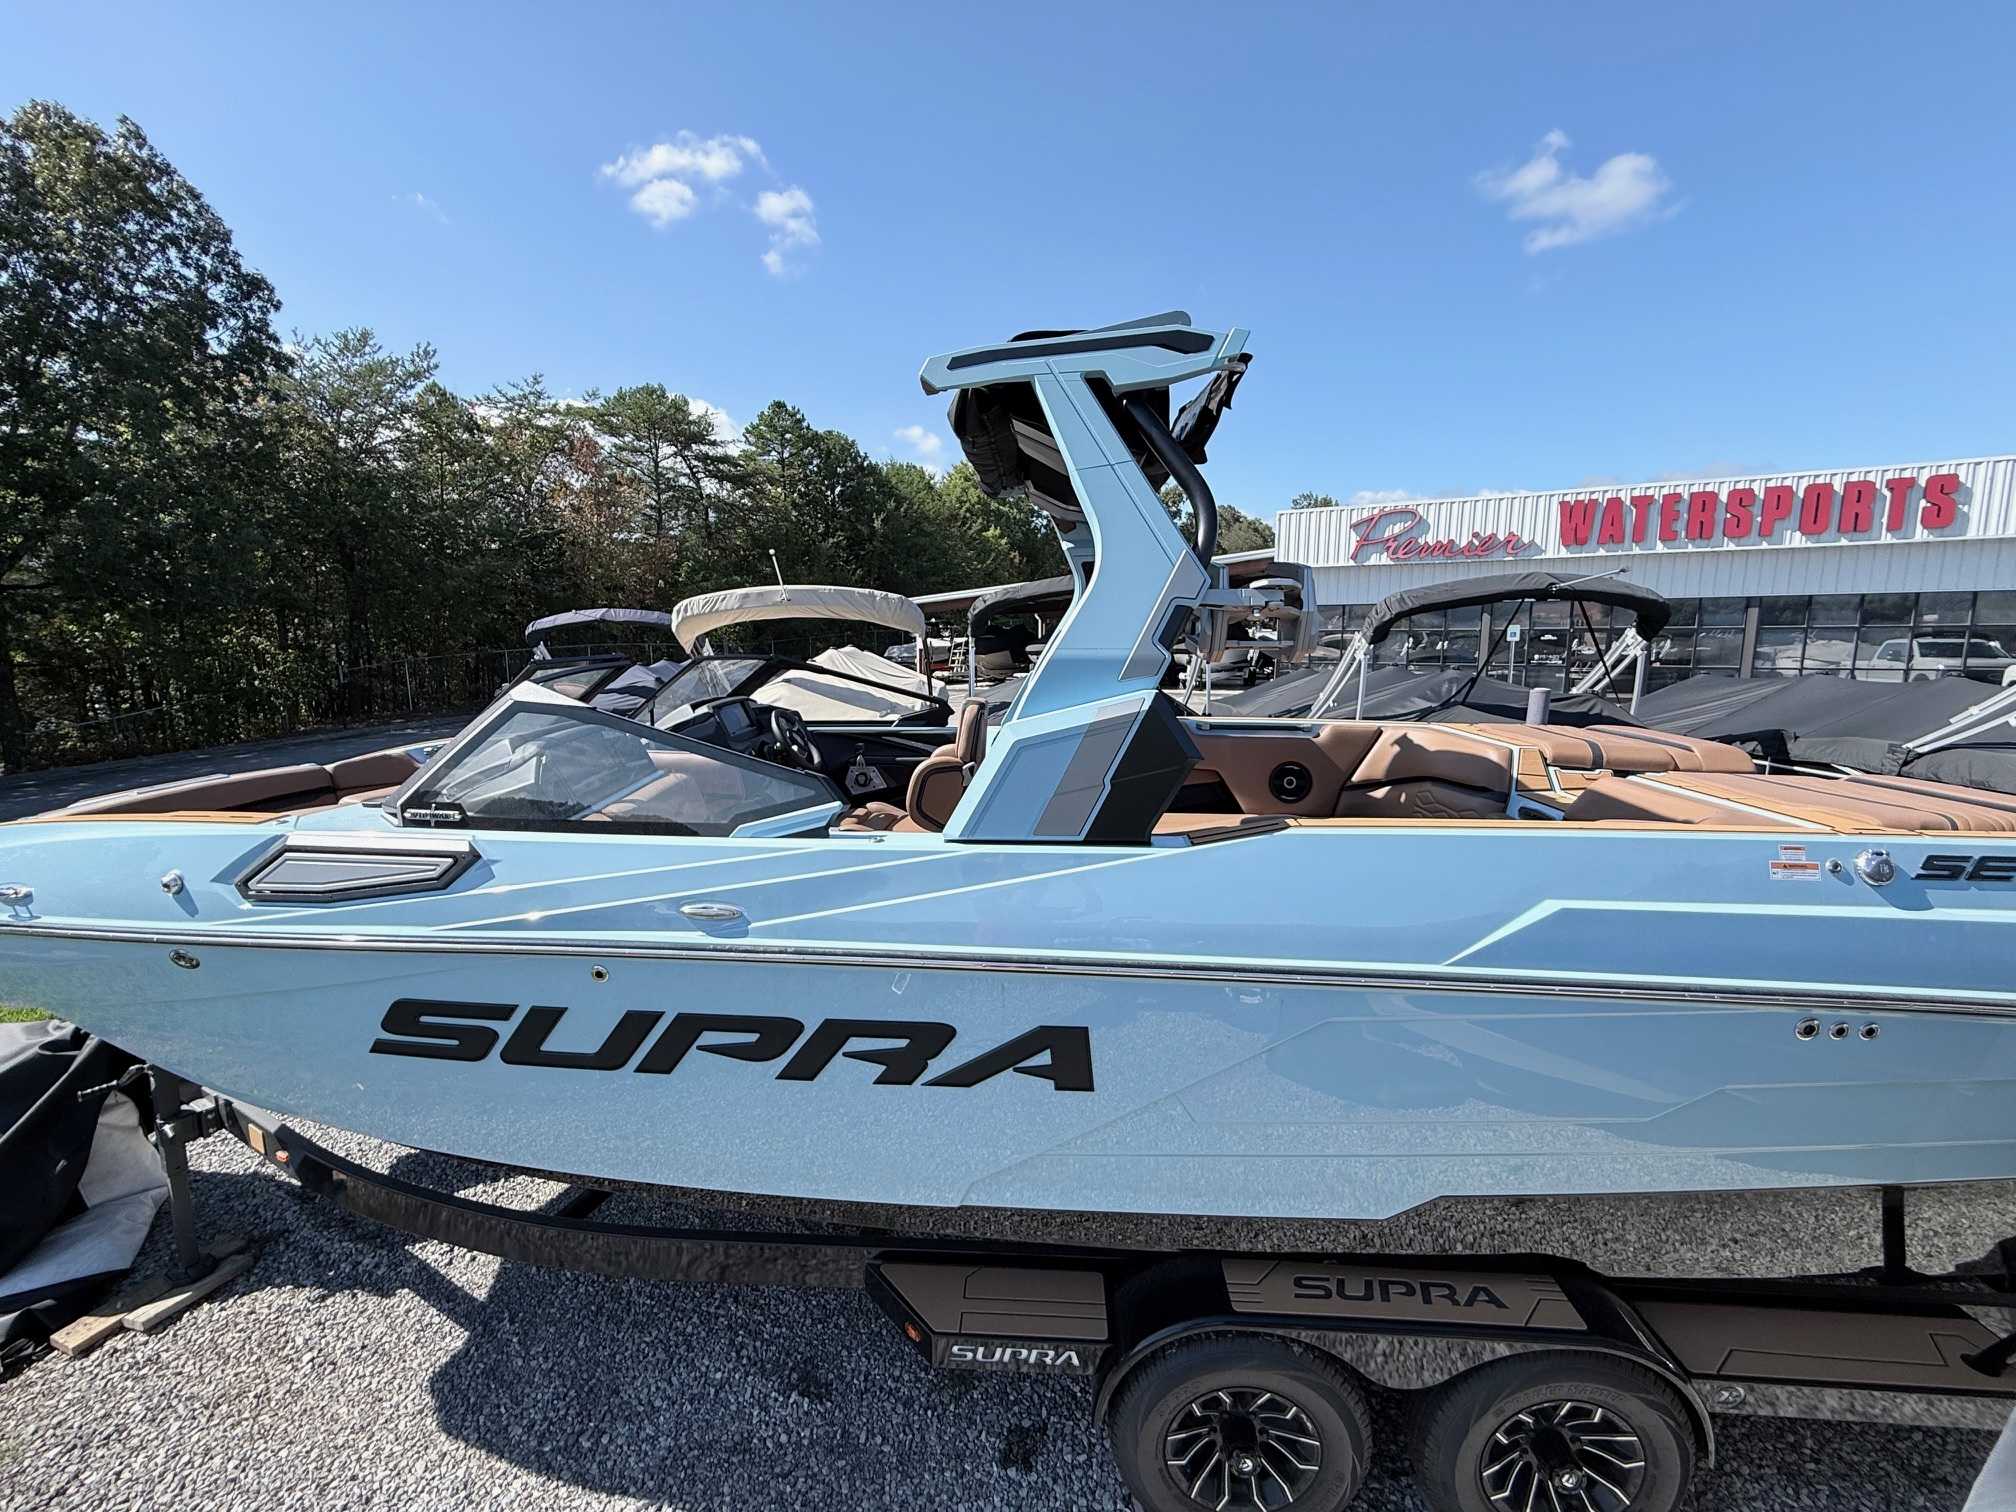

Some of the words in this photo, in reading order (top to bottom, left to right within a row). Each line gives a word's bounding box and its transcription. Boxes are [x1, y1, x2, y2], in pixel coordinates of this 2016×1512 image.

[1350, 507, 1535, 561] Premier
[1558, 473, 1961, 547] WATERSPORTS
[369, 997, 1095, 1091] SUPRA
[1292, 1274, 1511, 1310] SUPRA
[950, 1344, 1080, 1368] SUPRA
